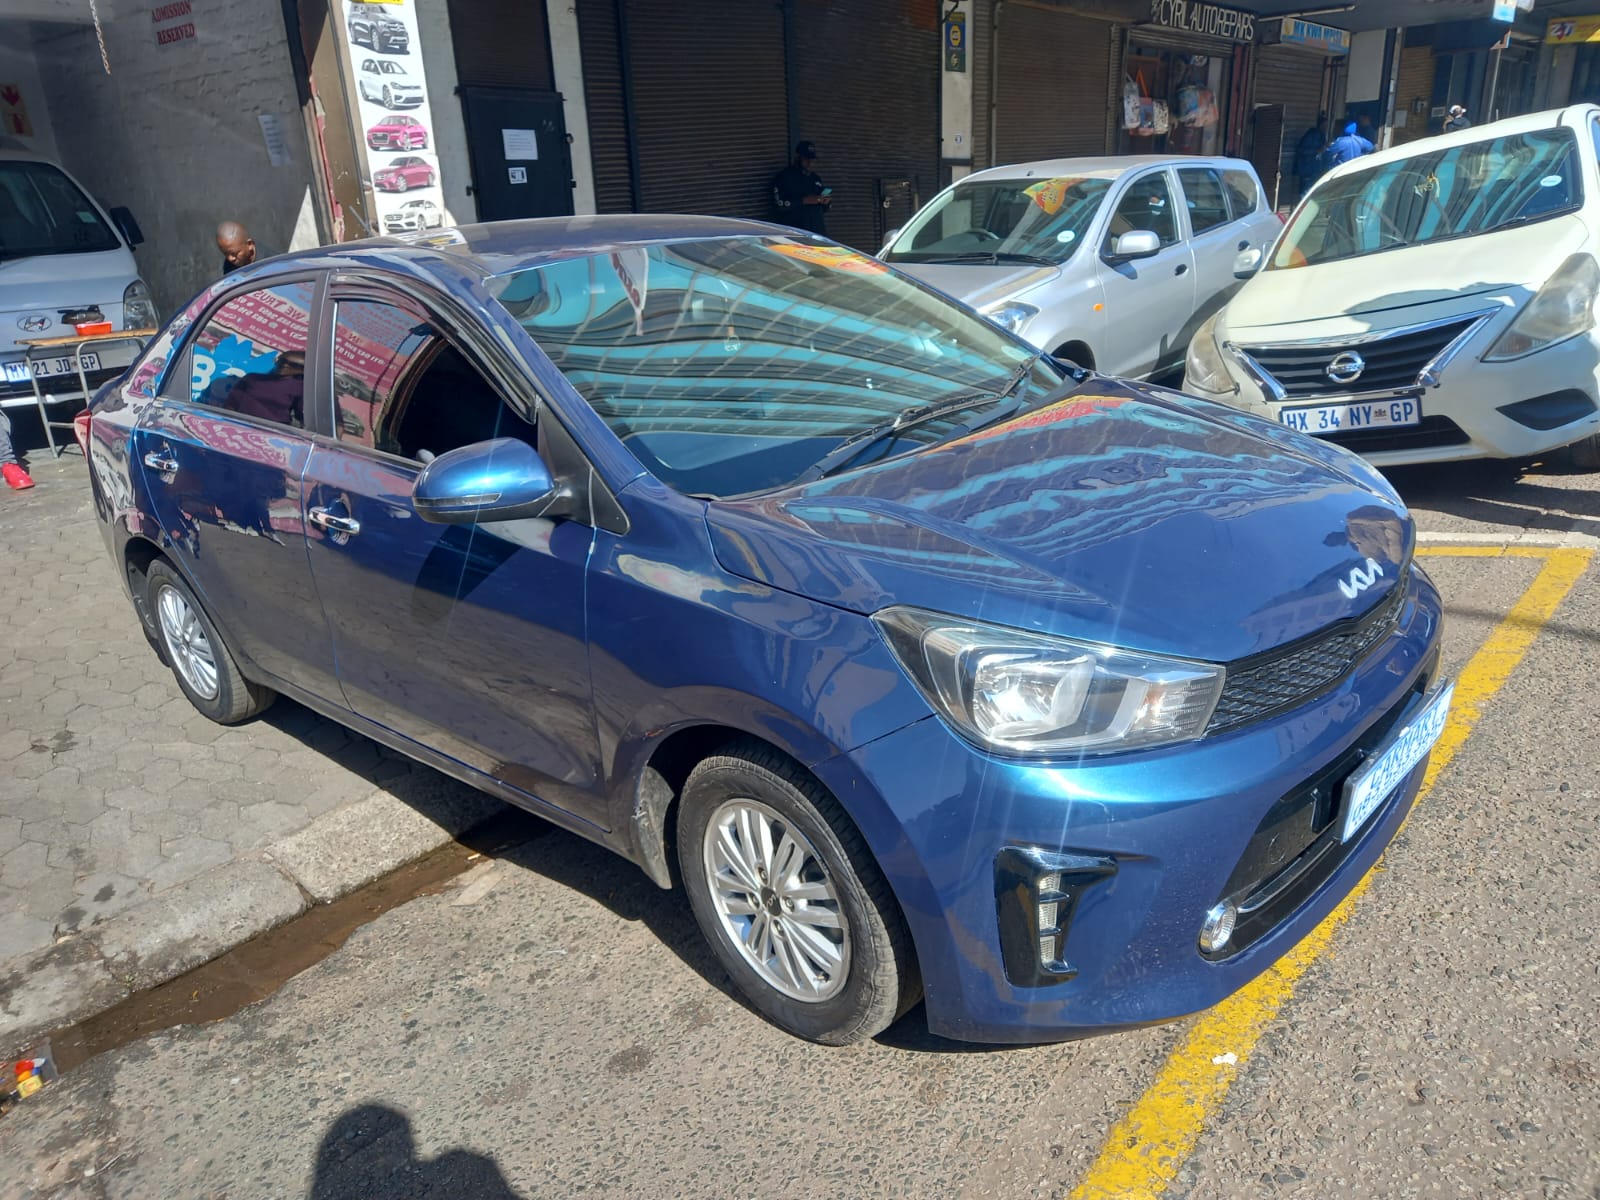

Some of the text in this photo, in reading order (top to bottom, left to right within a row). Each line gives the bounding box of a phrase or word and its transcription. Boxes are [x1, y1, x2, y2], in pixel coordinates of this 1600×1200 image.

[152, 0, 192, 24] ADMISSION
[157, 22, 195, 46] RESERVED
[32, 361, 50, 376] 21
[55, 359, 71, 373] JD
[81, 355, 97, 370] GP
[1286, 402, 1413, 431] HX 34 NY GP
